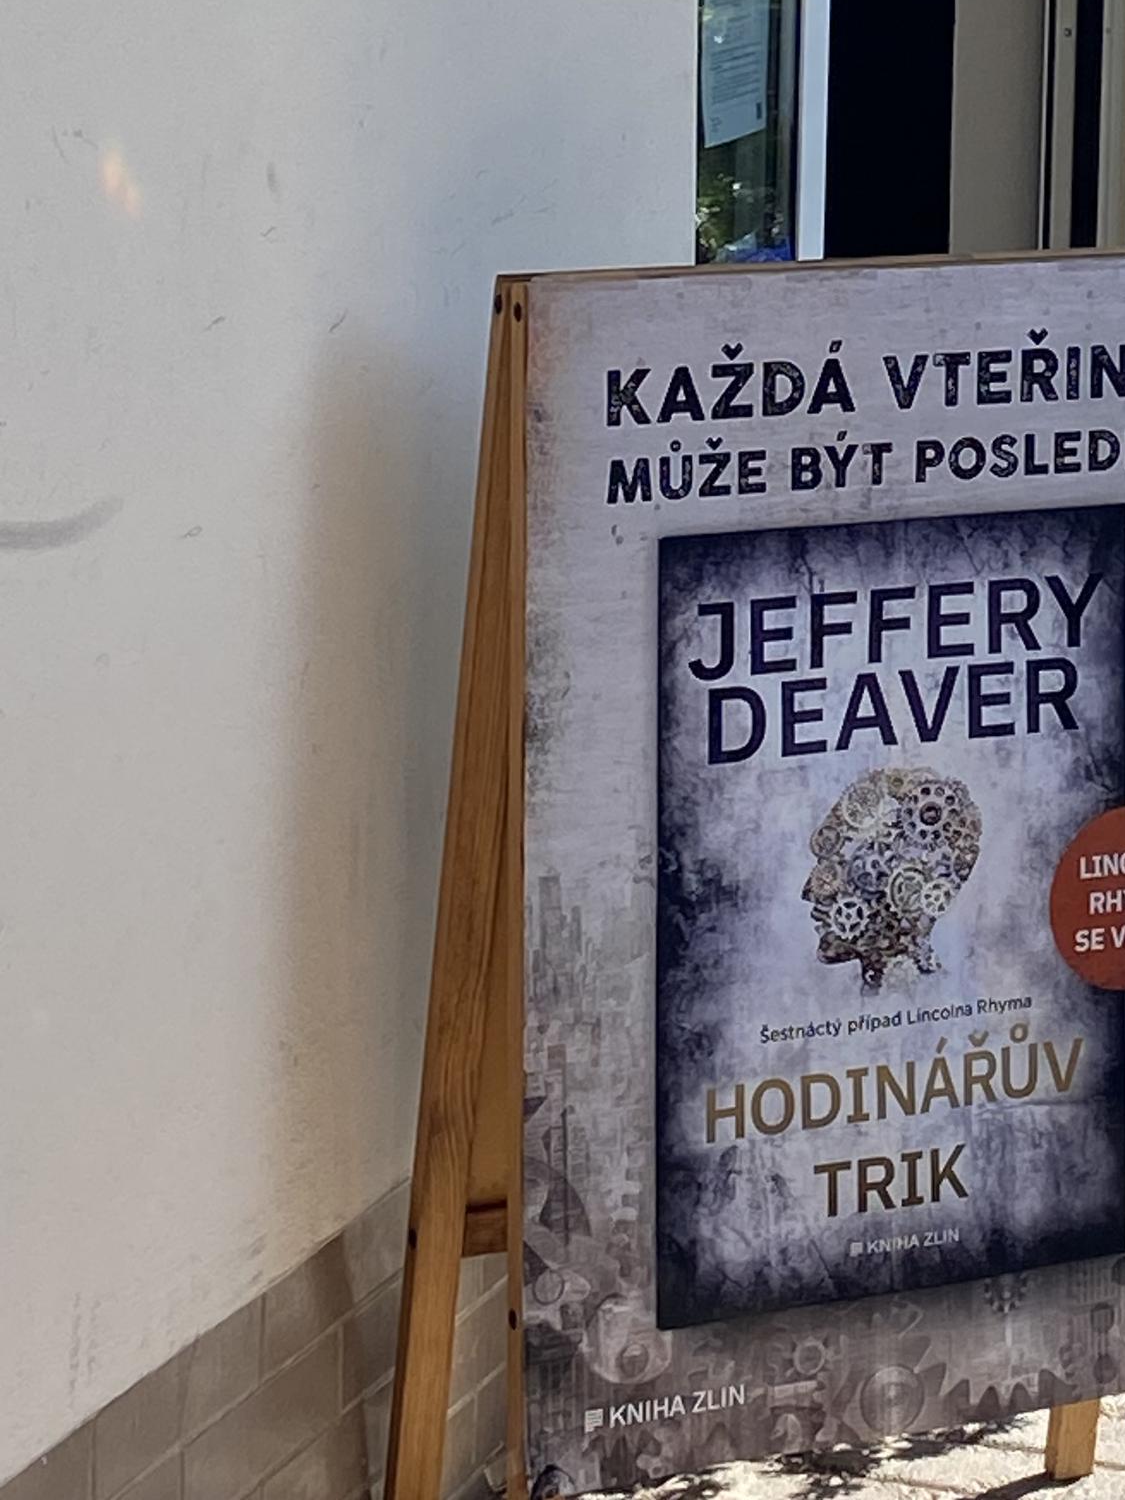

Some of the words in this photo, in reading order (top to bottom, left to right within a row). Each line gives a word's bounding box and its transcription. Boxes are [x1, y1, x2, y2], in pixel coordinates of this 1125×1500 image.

[605, 339, 856, 428] KAŽDÁ
[606, 437, 767, 505] MŮŽE
[790, 430, 893, 492] BÝT
[687, 572, 1103, 682] JEFFERY
[706, 658, 1081, 766] DEAVER
[1074, 927, 1106, 953] SE
[759, 1019, 843, 1044] Šestnáctý
[847, 1010, 902, 1036] případ
[906, 1002, 973, 1026] Lincolna
[976, 995, 1033, 1016] Rhyma
[704, 1022, 1085, 1145] HODINÁŘŮV
[813, 1143, 970, 1219] TRIK
[866, 1234, 919, 1255] KNIHA
[922, 1227, 960, 1247] ZLIN
[608, 1393, 686, 1429] KNIHA
[692, 1383, 746, 1414] ZLIN
